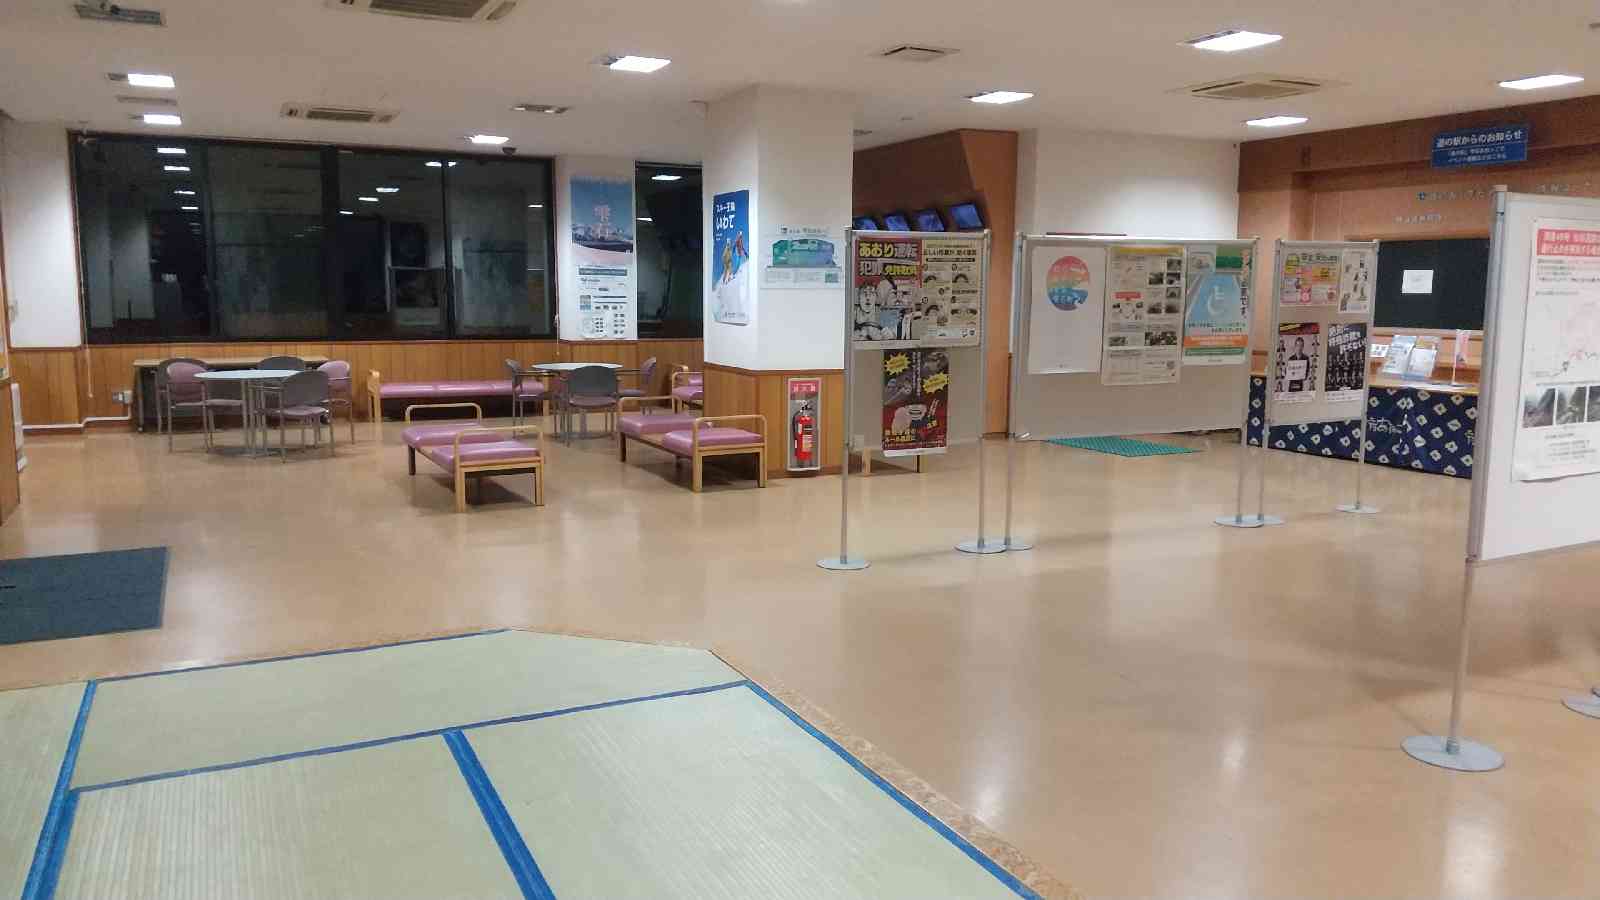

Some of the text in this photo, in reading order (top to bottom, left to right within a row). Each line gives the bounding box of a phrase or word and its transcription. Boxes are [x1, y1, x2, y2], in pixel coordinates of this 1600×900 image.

[716, 214, 735, 230] いわて
[859, 241, 917, 258] あおり運転
